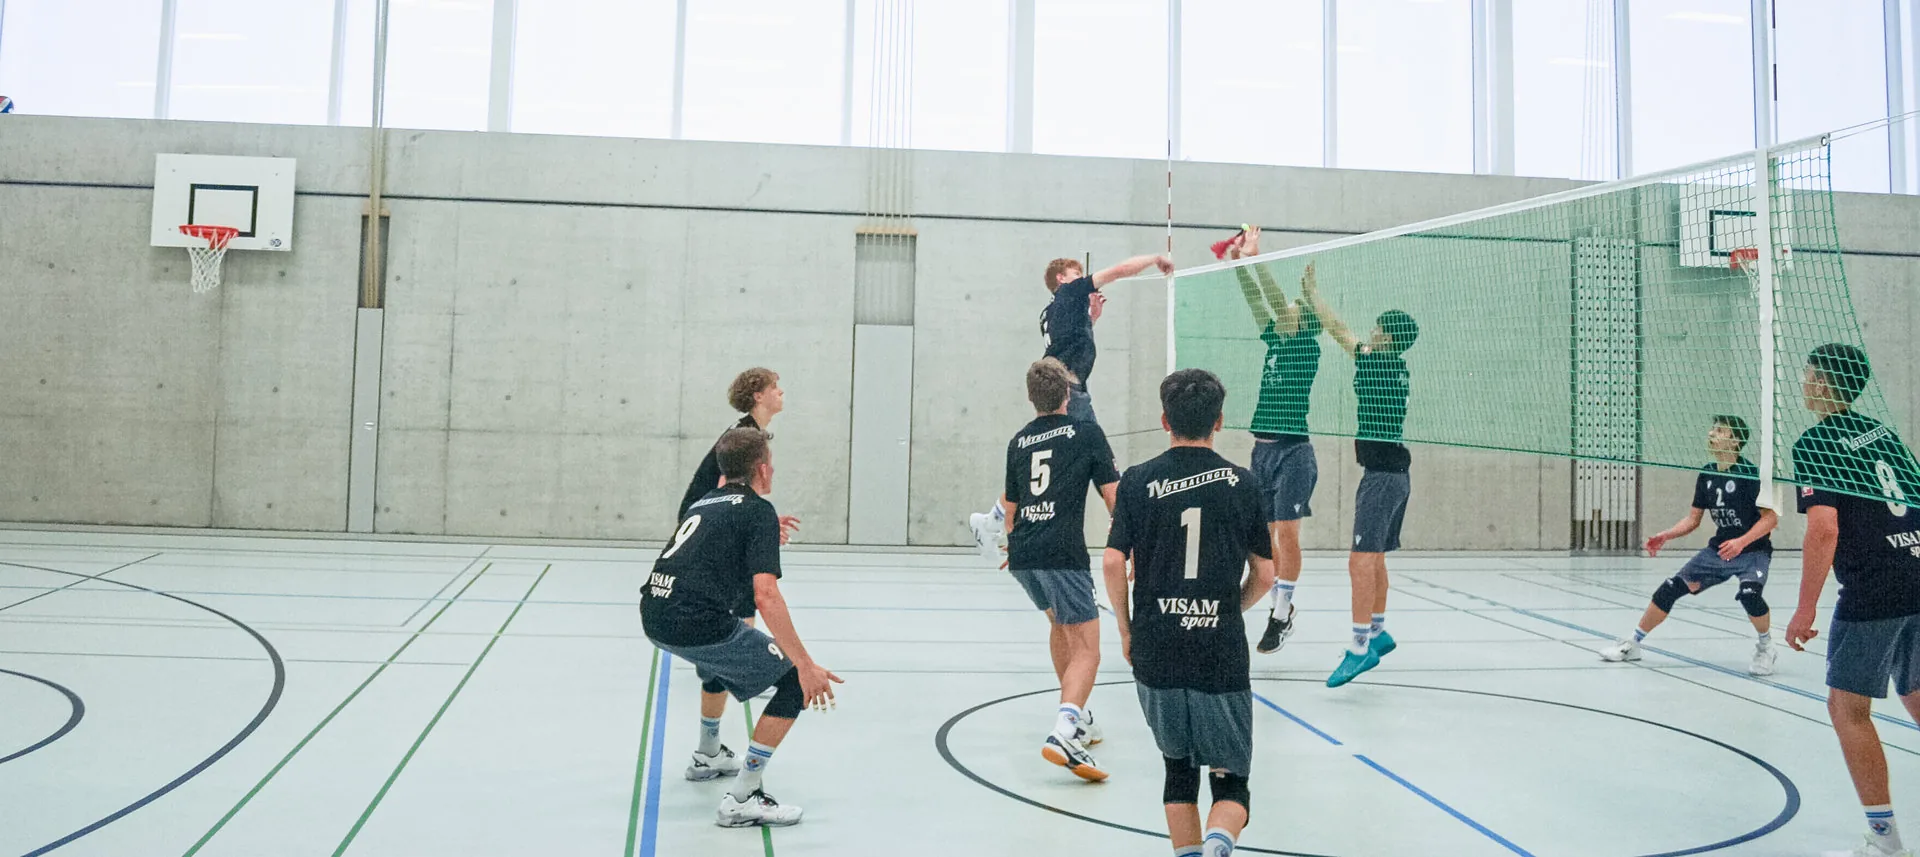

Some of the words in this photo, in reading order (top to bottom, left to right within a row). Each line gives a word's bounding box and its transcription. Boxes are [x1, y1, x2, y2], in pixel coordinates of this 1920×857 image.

[1029, 449, 1053, 496] 5
[1876, 459, 1907, 517] 8
[1716, 488, 1725, 507] 2
[661, 514, 702, 559] 9
[1180, 507, 1202, 580] 1
[1157, 598, 1220, 615] VISAM
[1180, 614, 1220, 631] sport
[767, 642, 785, 661] 9
